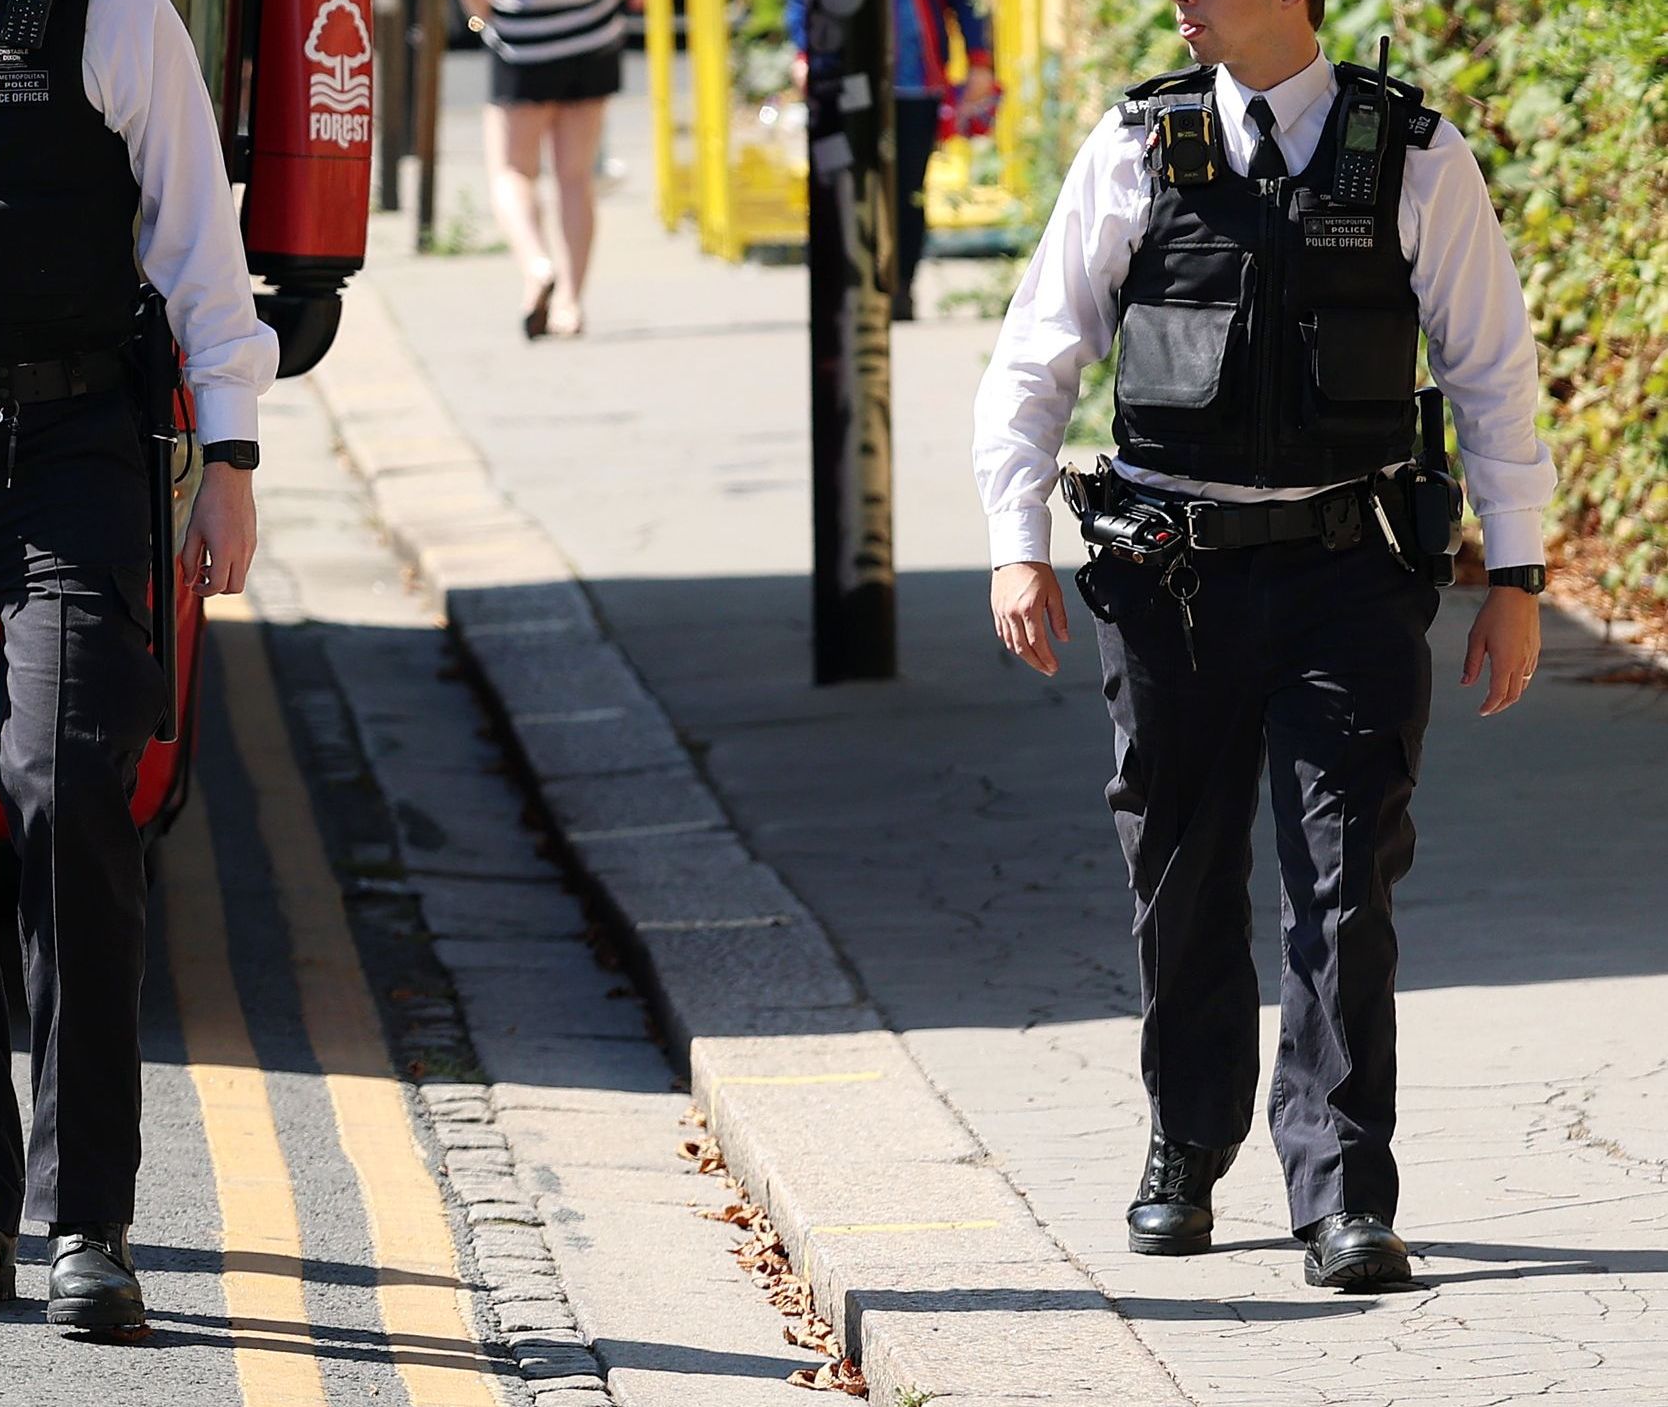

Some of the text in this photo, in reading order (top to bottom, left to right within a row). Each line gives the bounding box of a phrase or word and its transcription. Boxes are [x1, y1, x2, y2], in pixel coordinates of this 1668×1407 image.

[12, 92, 49, 102] OFFICER
[1305, 237, 1373, 248] POLICE OFFICER
